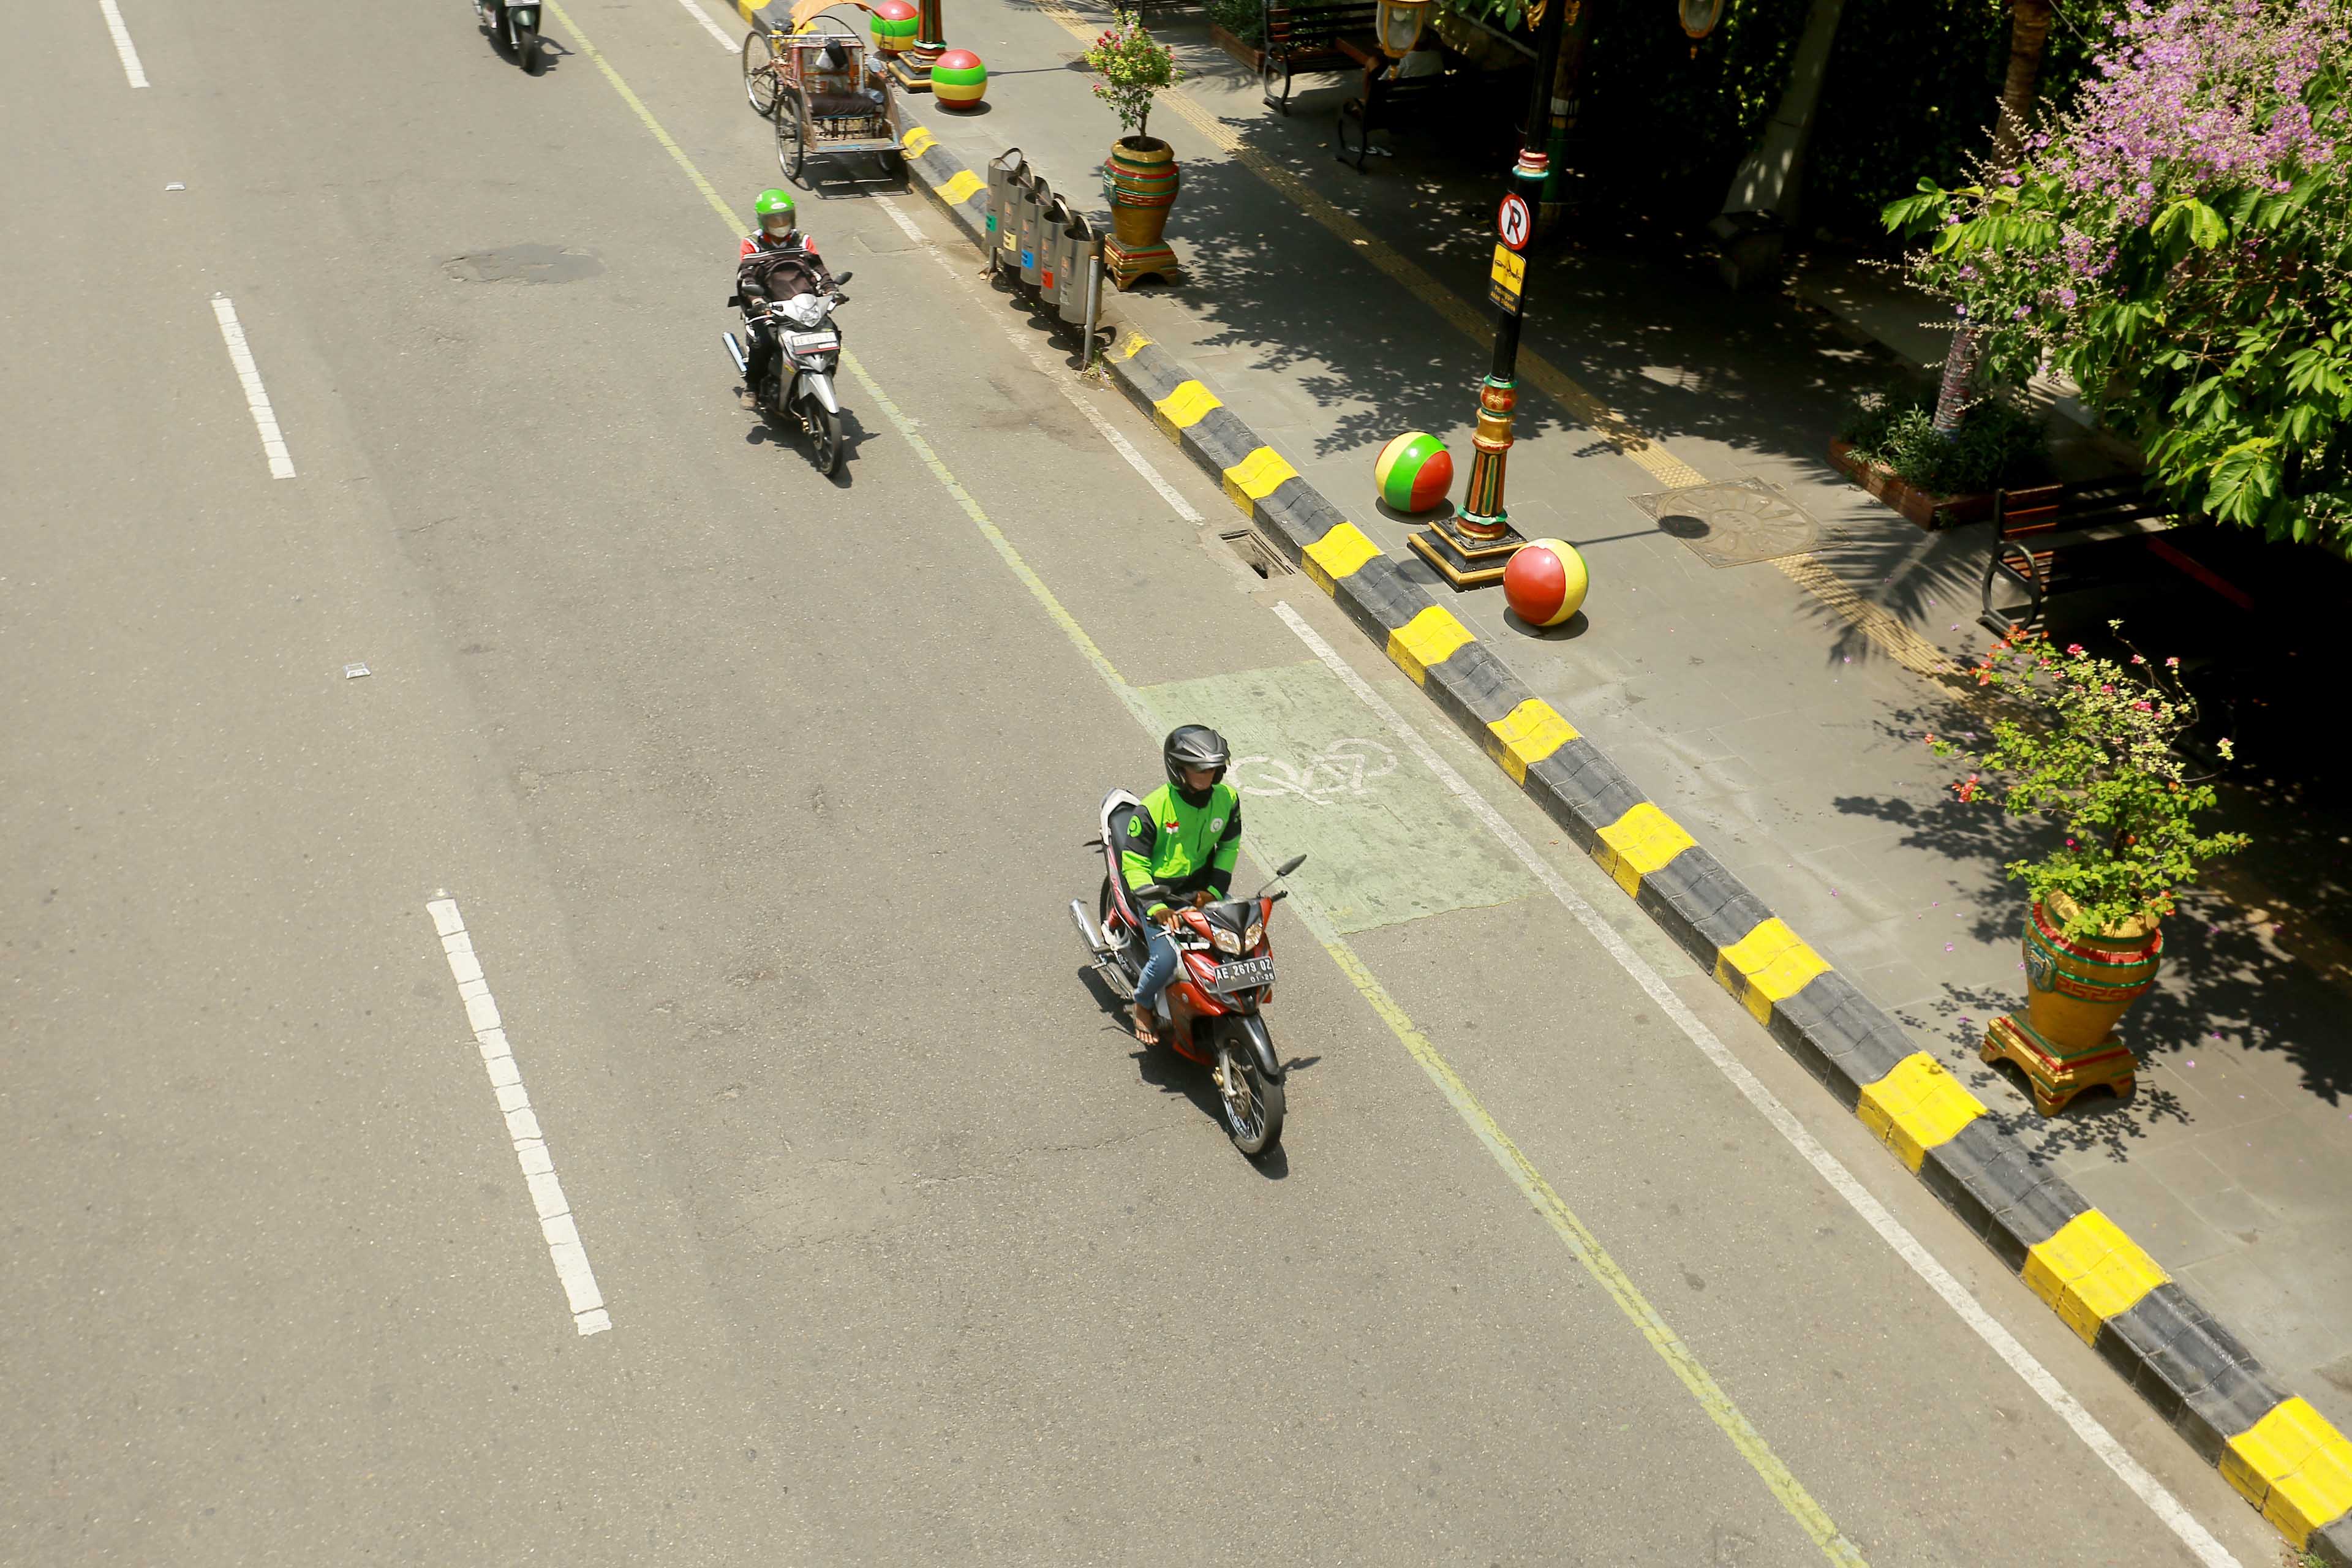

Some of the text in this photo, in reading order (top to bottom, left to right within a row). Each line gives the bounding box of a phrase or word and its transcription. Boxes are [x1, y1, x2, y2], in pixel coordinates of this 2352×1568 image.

[1506, 205, 1521, 235] P
[1216, 967, 1229, 981] AE
[1233, 962, 1256, 977] 2679
